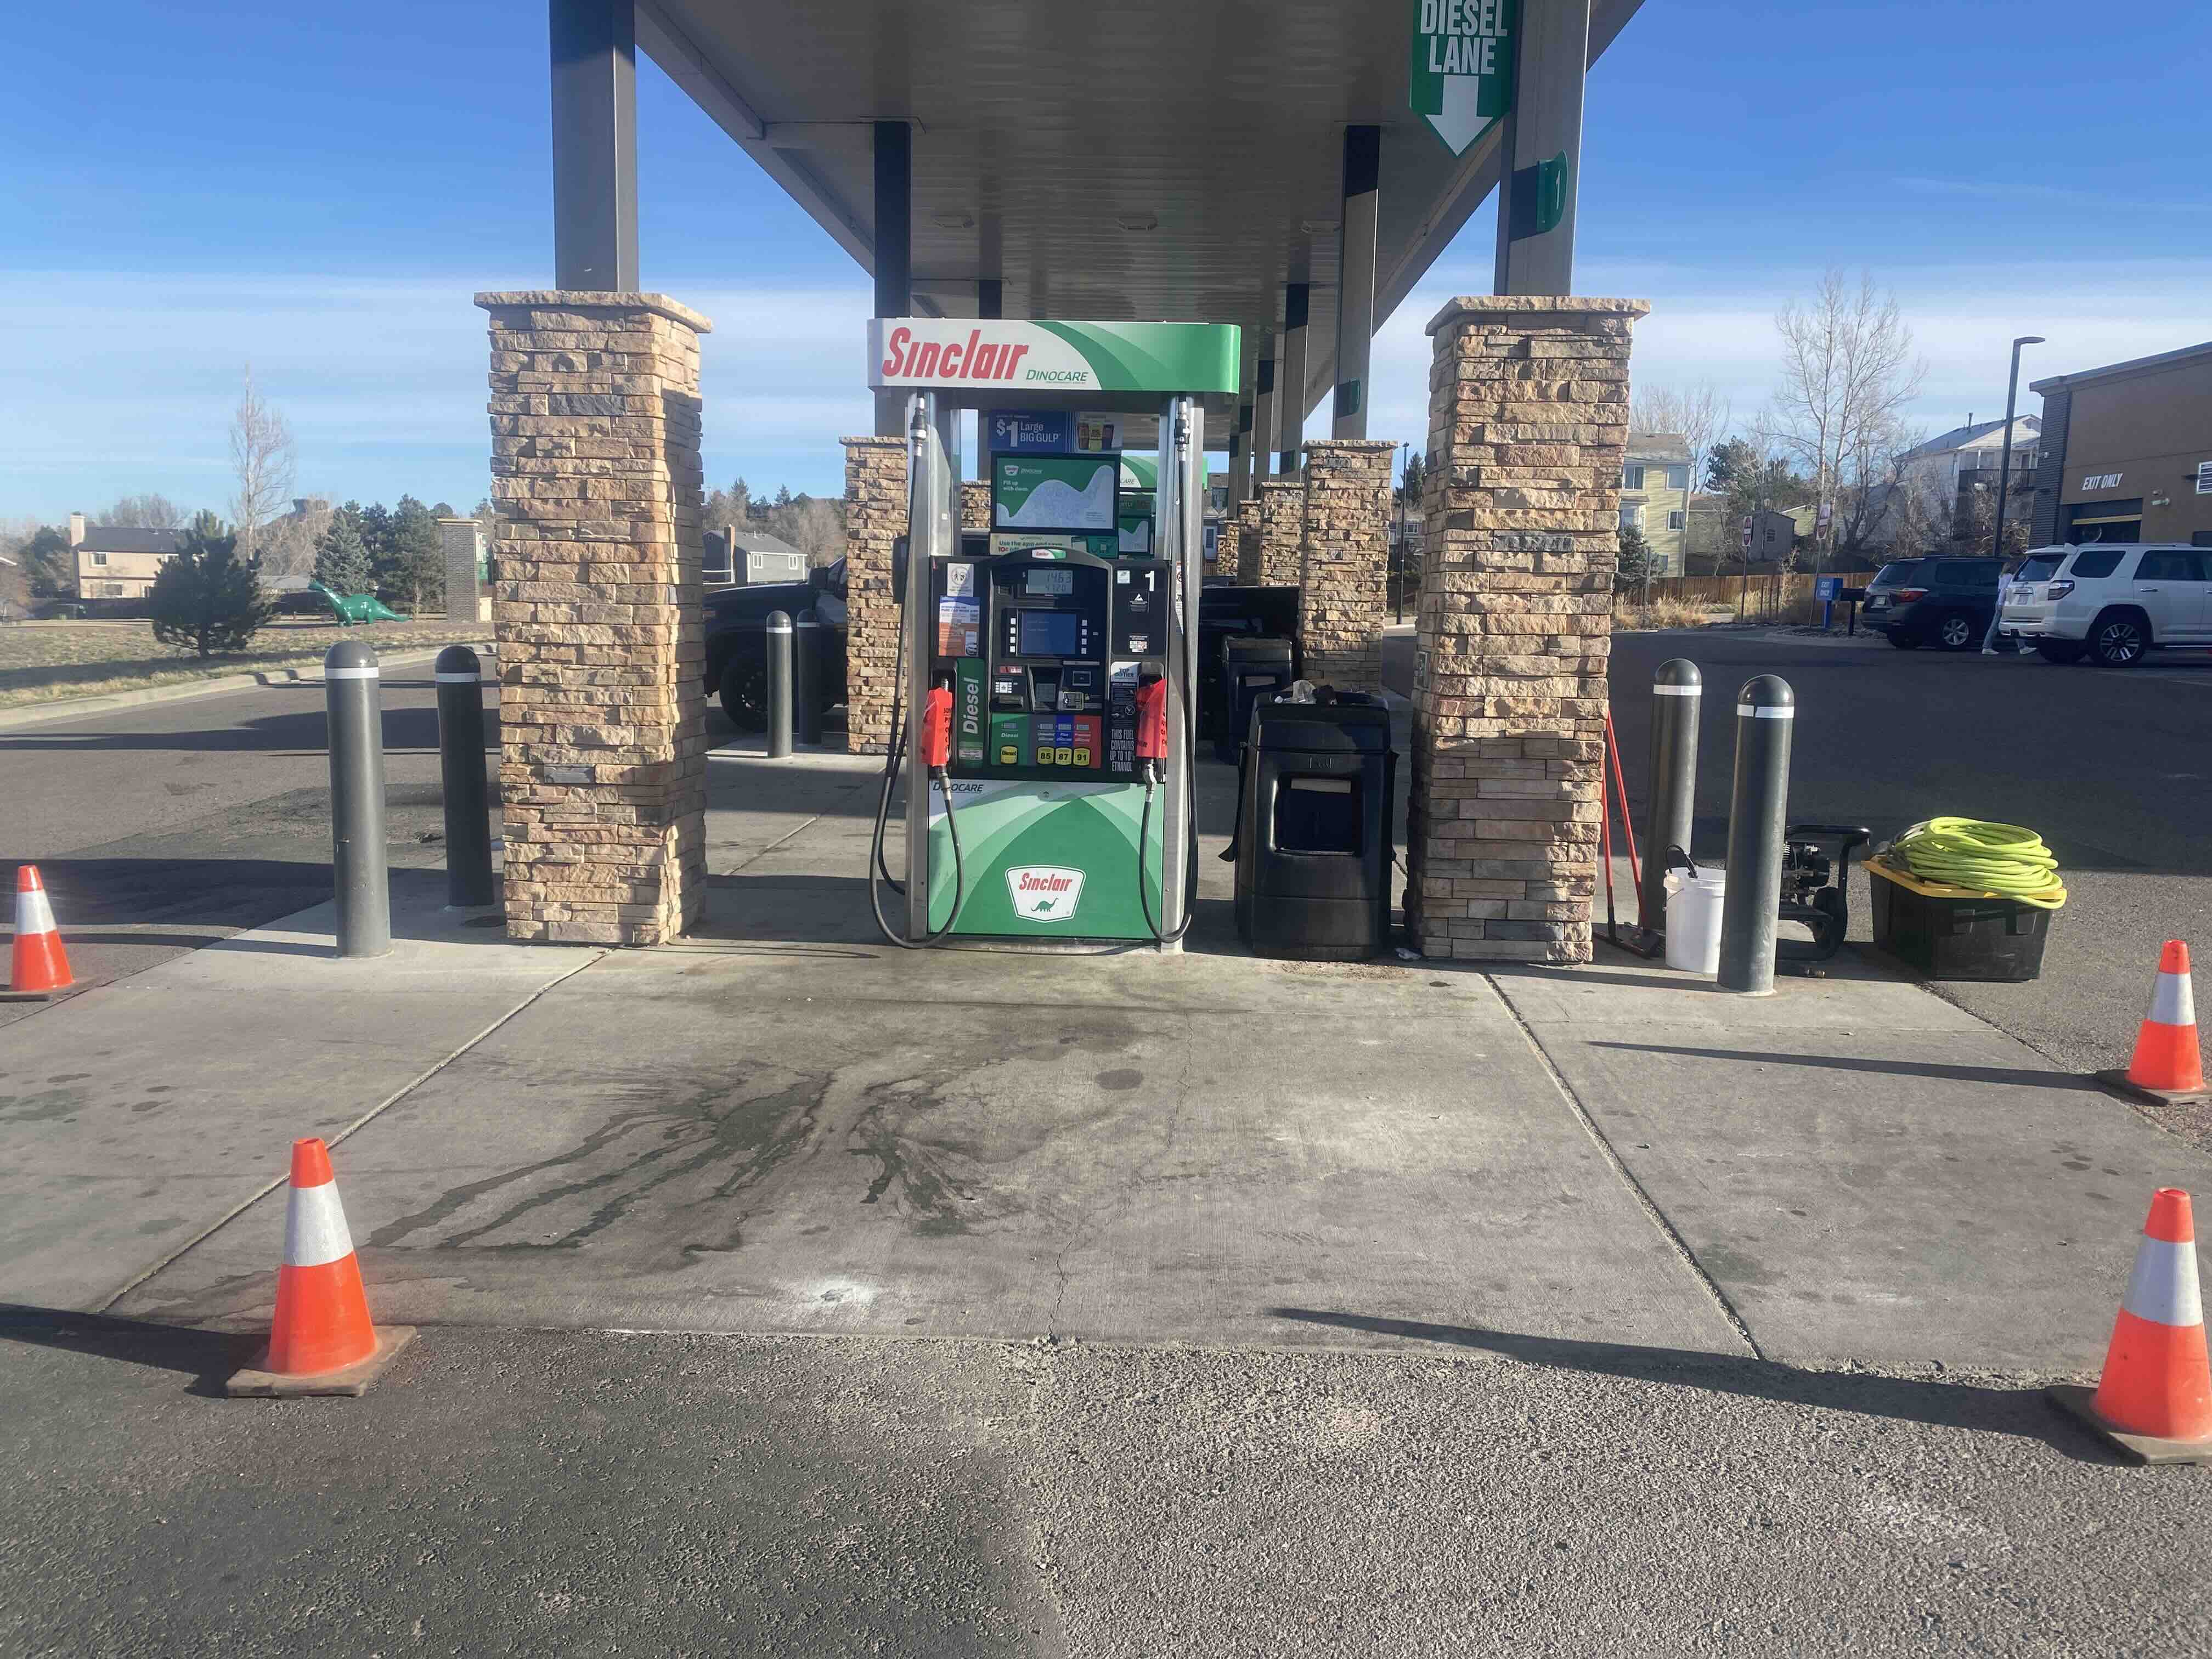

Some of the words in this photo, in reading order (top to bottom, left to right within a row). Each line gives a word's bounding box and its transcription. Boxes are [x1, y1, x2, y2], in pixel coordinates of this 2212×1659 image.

[1420, 0, 1508, 36] DIESEL
[1428, 36, 1497, 75] LANE
[882, 326, 1029, 380] Sinclair
[1025, 369, 1089, 382] DINOCARE
[1020, 420, 1043, 433] Large
[1020, 432, 1034, 442] BIG
[1036, 433, 1059, 444] GULP
[2082, 476, 2102, 490] EXIT
[2101, 472, 2124, 489] ONLY
[1145, 570, 1155, 591] 1
[962, 677, 979, 734] Diesel
[1111, 729, 1122, 740] THIS
[1123, 729, 1135, 740] FUEL
[1110, 740, 1135, 751] CONTAINS
[1110, 751, 1116, 761] UP
[1118, 751, 1124, 761] TO
[1111, 761, 1133, 772] ETHANOL
[933, 782, 984, 792] DOCARE
[1019, 872, 1073, 891] Sinclair
